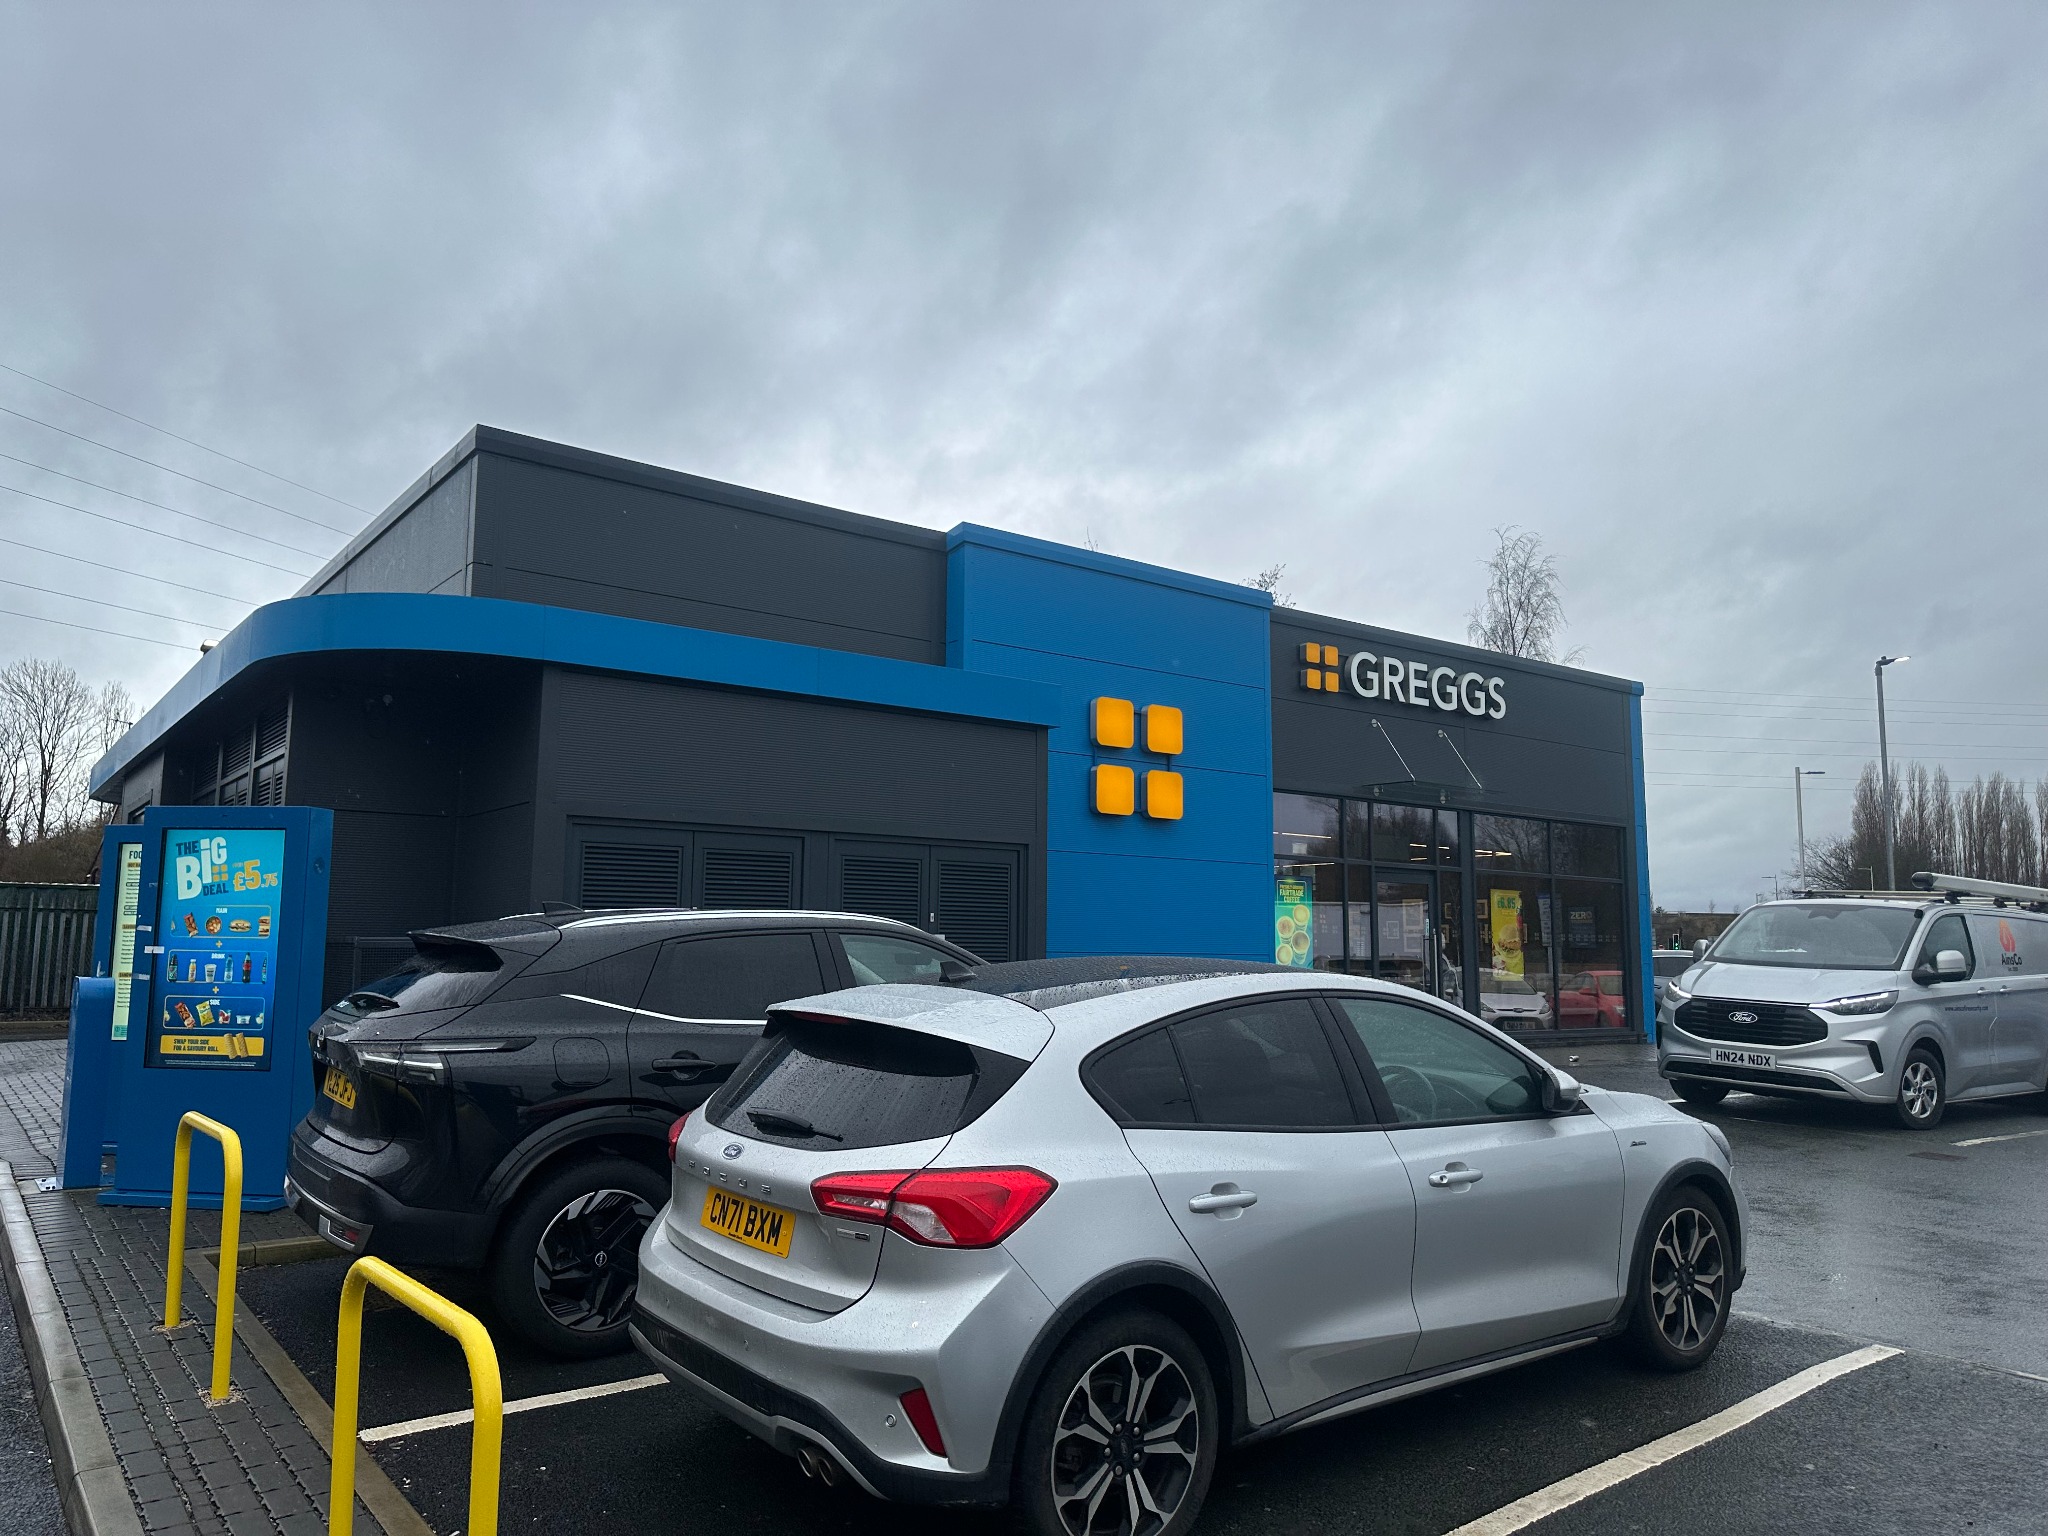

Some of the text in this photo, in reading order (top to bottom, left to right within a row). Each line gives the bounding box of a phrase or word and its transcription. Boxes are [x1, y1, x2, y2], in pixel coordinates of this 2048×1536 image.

[1350, 651, 1507, 720] GREGGS
[176, 841, 200, 856] THE
[203, 883, 229, 896] DEAL
[1279, 889, 1304, 897] FAIRTRADE
[1570, 911, 1593, 920] ZERO
[1733, 1011, 1753, 1022] Ford
[1716, 1050, 1771, 1067] HN24 NDX
[709, 1192, 784, 1247] CN71 BXM
